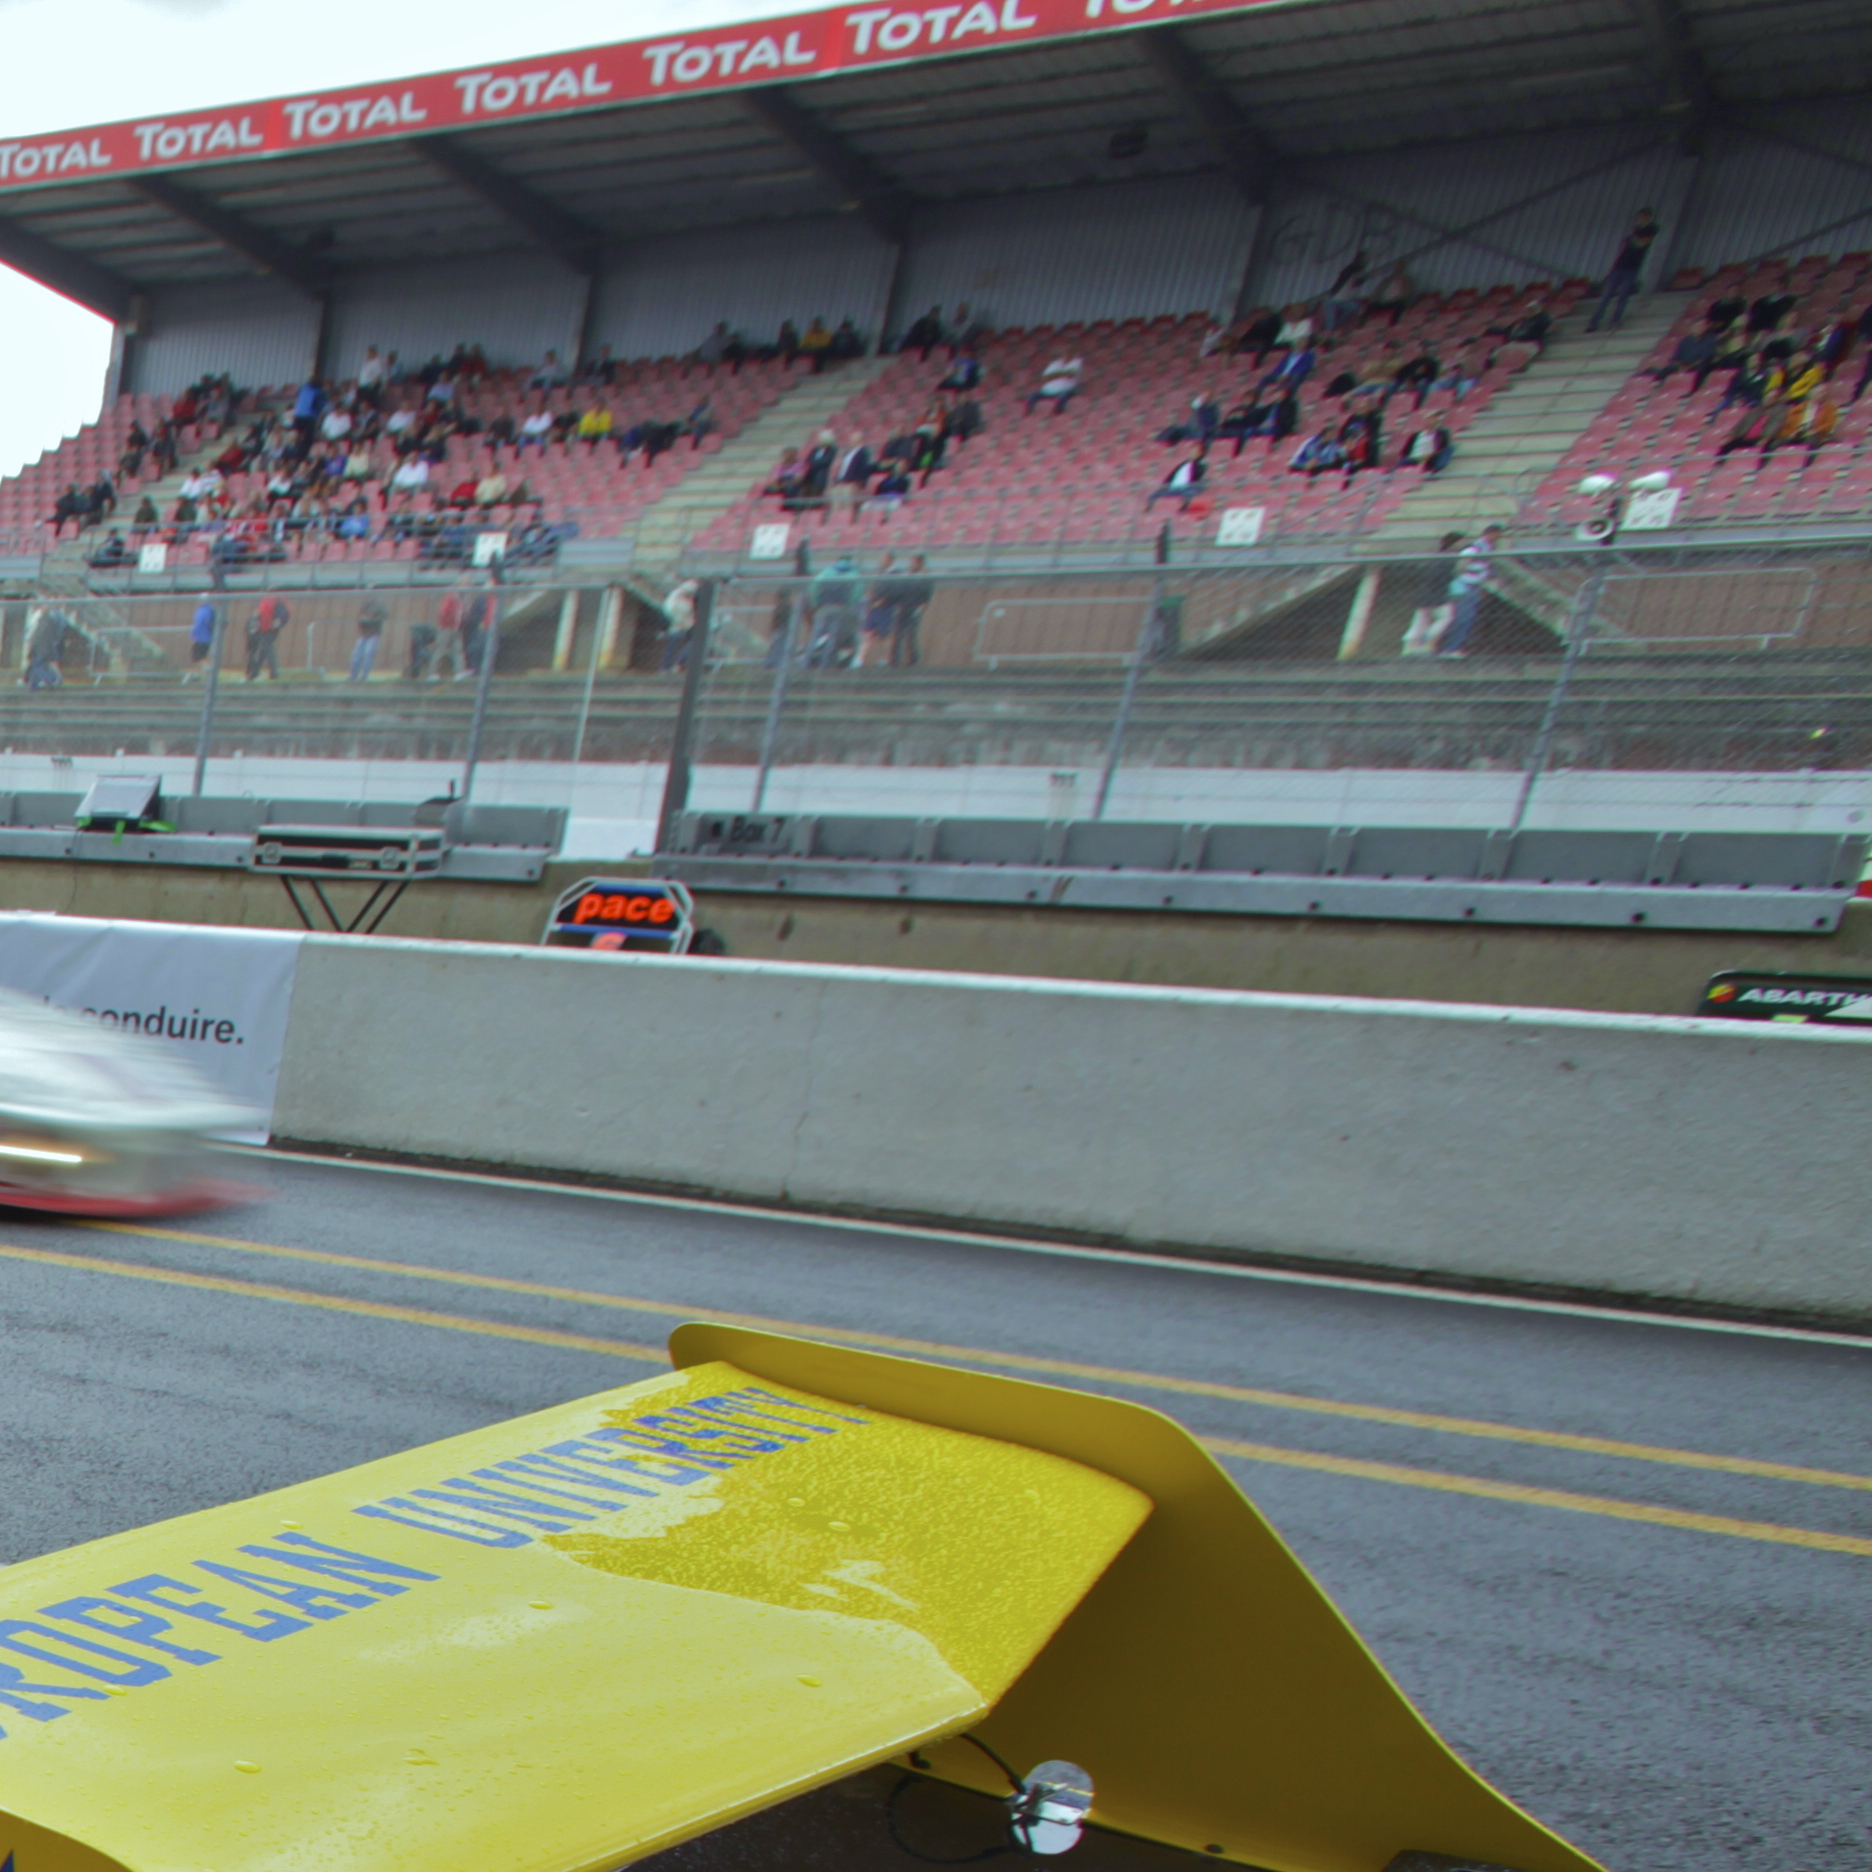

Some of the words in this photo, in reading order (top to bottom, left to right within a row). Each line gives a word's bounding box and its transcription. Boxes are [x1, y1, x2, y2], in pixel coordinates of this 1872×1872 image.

[134, 119, 263, 161] TOTAL
[283, 90, 426, 139] TOTAL
[456, 62, 611, 114] TOTAL
[643, 30, 815, 88] TOTAL
[730, 817, 767, 843] Box
[771, 818, 787, 844] 7
[573, 893, 674, 924] pace
[354, 1386, 870, 1549] UNIVERSITY
